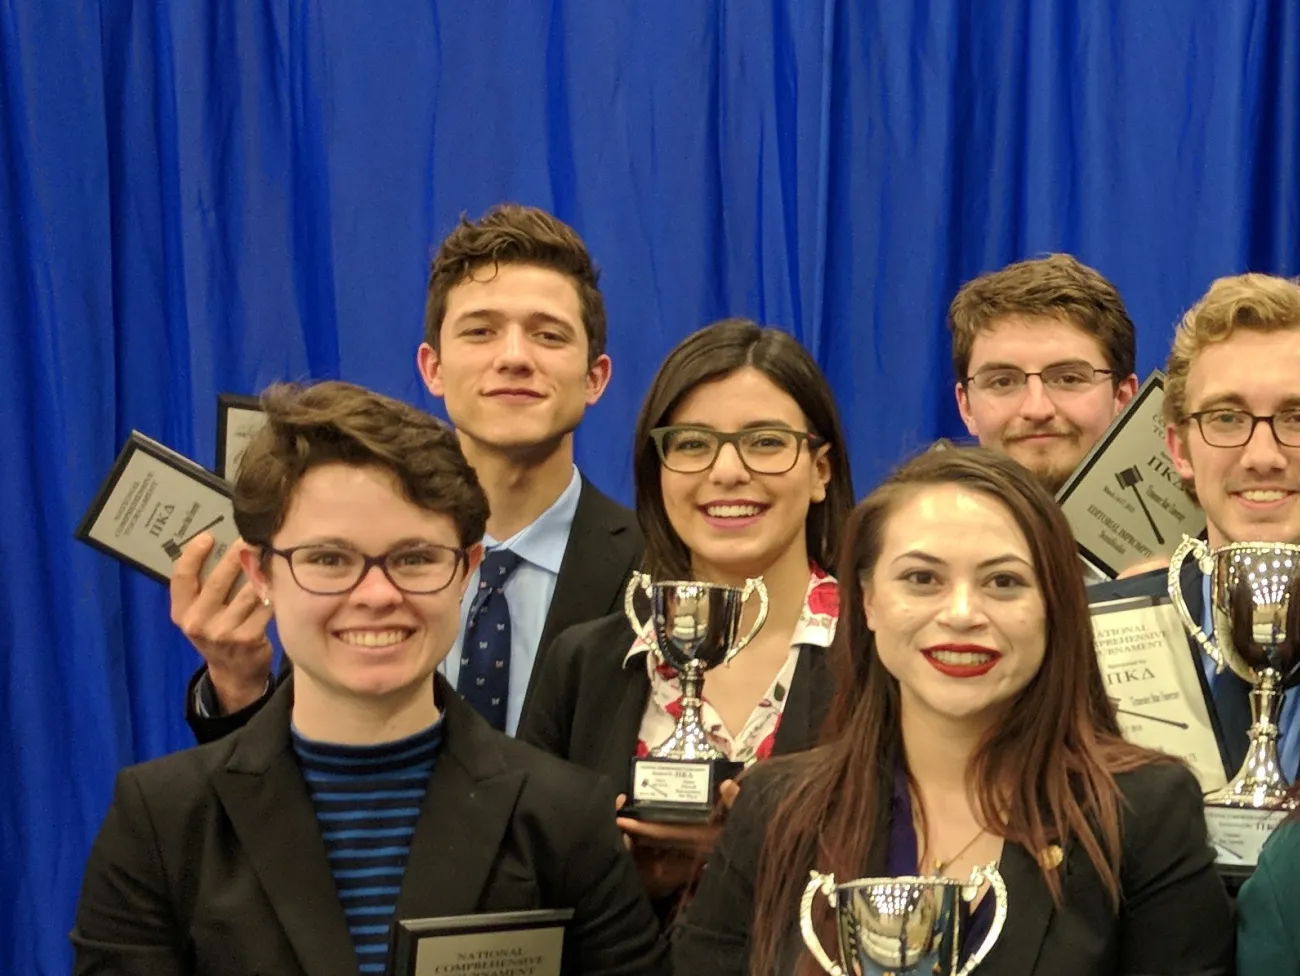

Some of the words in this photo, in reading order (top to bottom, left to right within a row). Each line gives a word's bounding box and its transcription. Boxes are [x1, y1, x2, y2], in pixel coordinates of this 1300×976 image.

[1096, 624, 1147, 639] ATIONAL
[1106, 667, 1156, 685] ΠΚΔ
[456, 947, 524, 962] NATIONAL
[434, 955, 542, 974] COMPREHENSIVE
